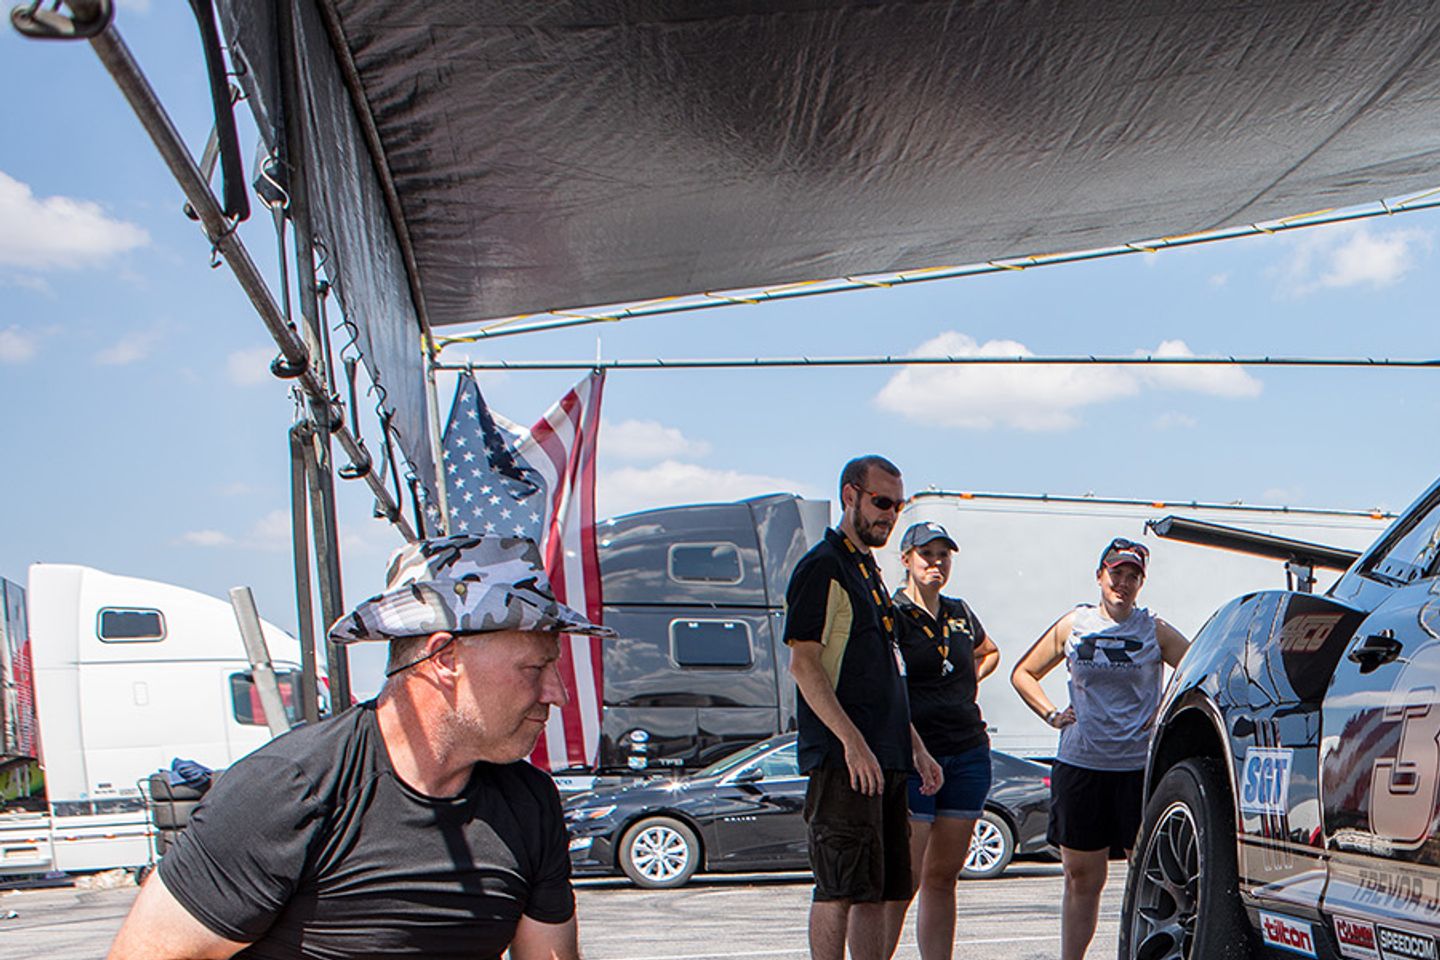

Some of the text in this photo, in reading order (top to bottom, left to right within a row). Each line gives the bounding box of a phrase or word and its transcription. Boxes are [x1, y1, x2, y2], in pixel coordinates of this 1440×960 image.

[1244, 756, 1288, 804] SGT
[1352, 869, 1424, 912] TREVOR
[1263, 917, 1313, 952] tilton
[1380, 929, 1436, 960] SPEEDCOM
